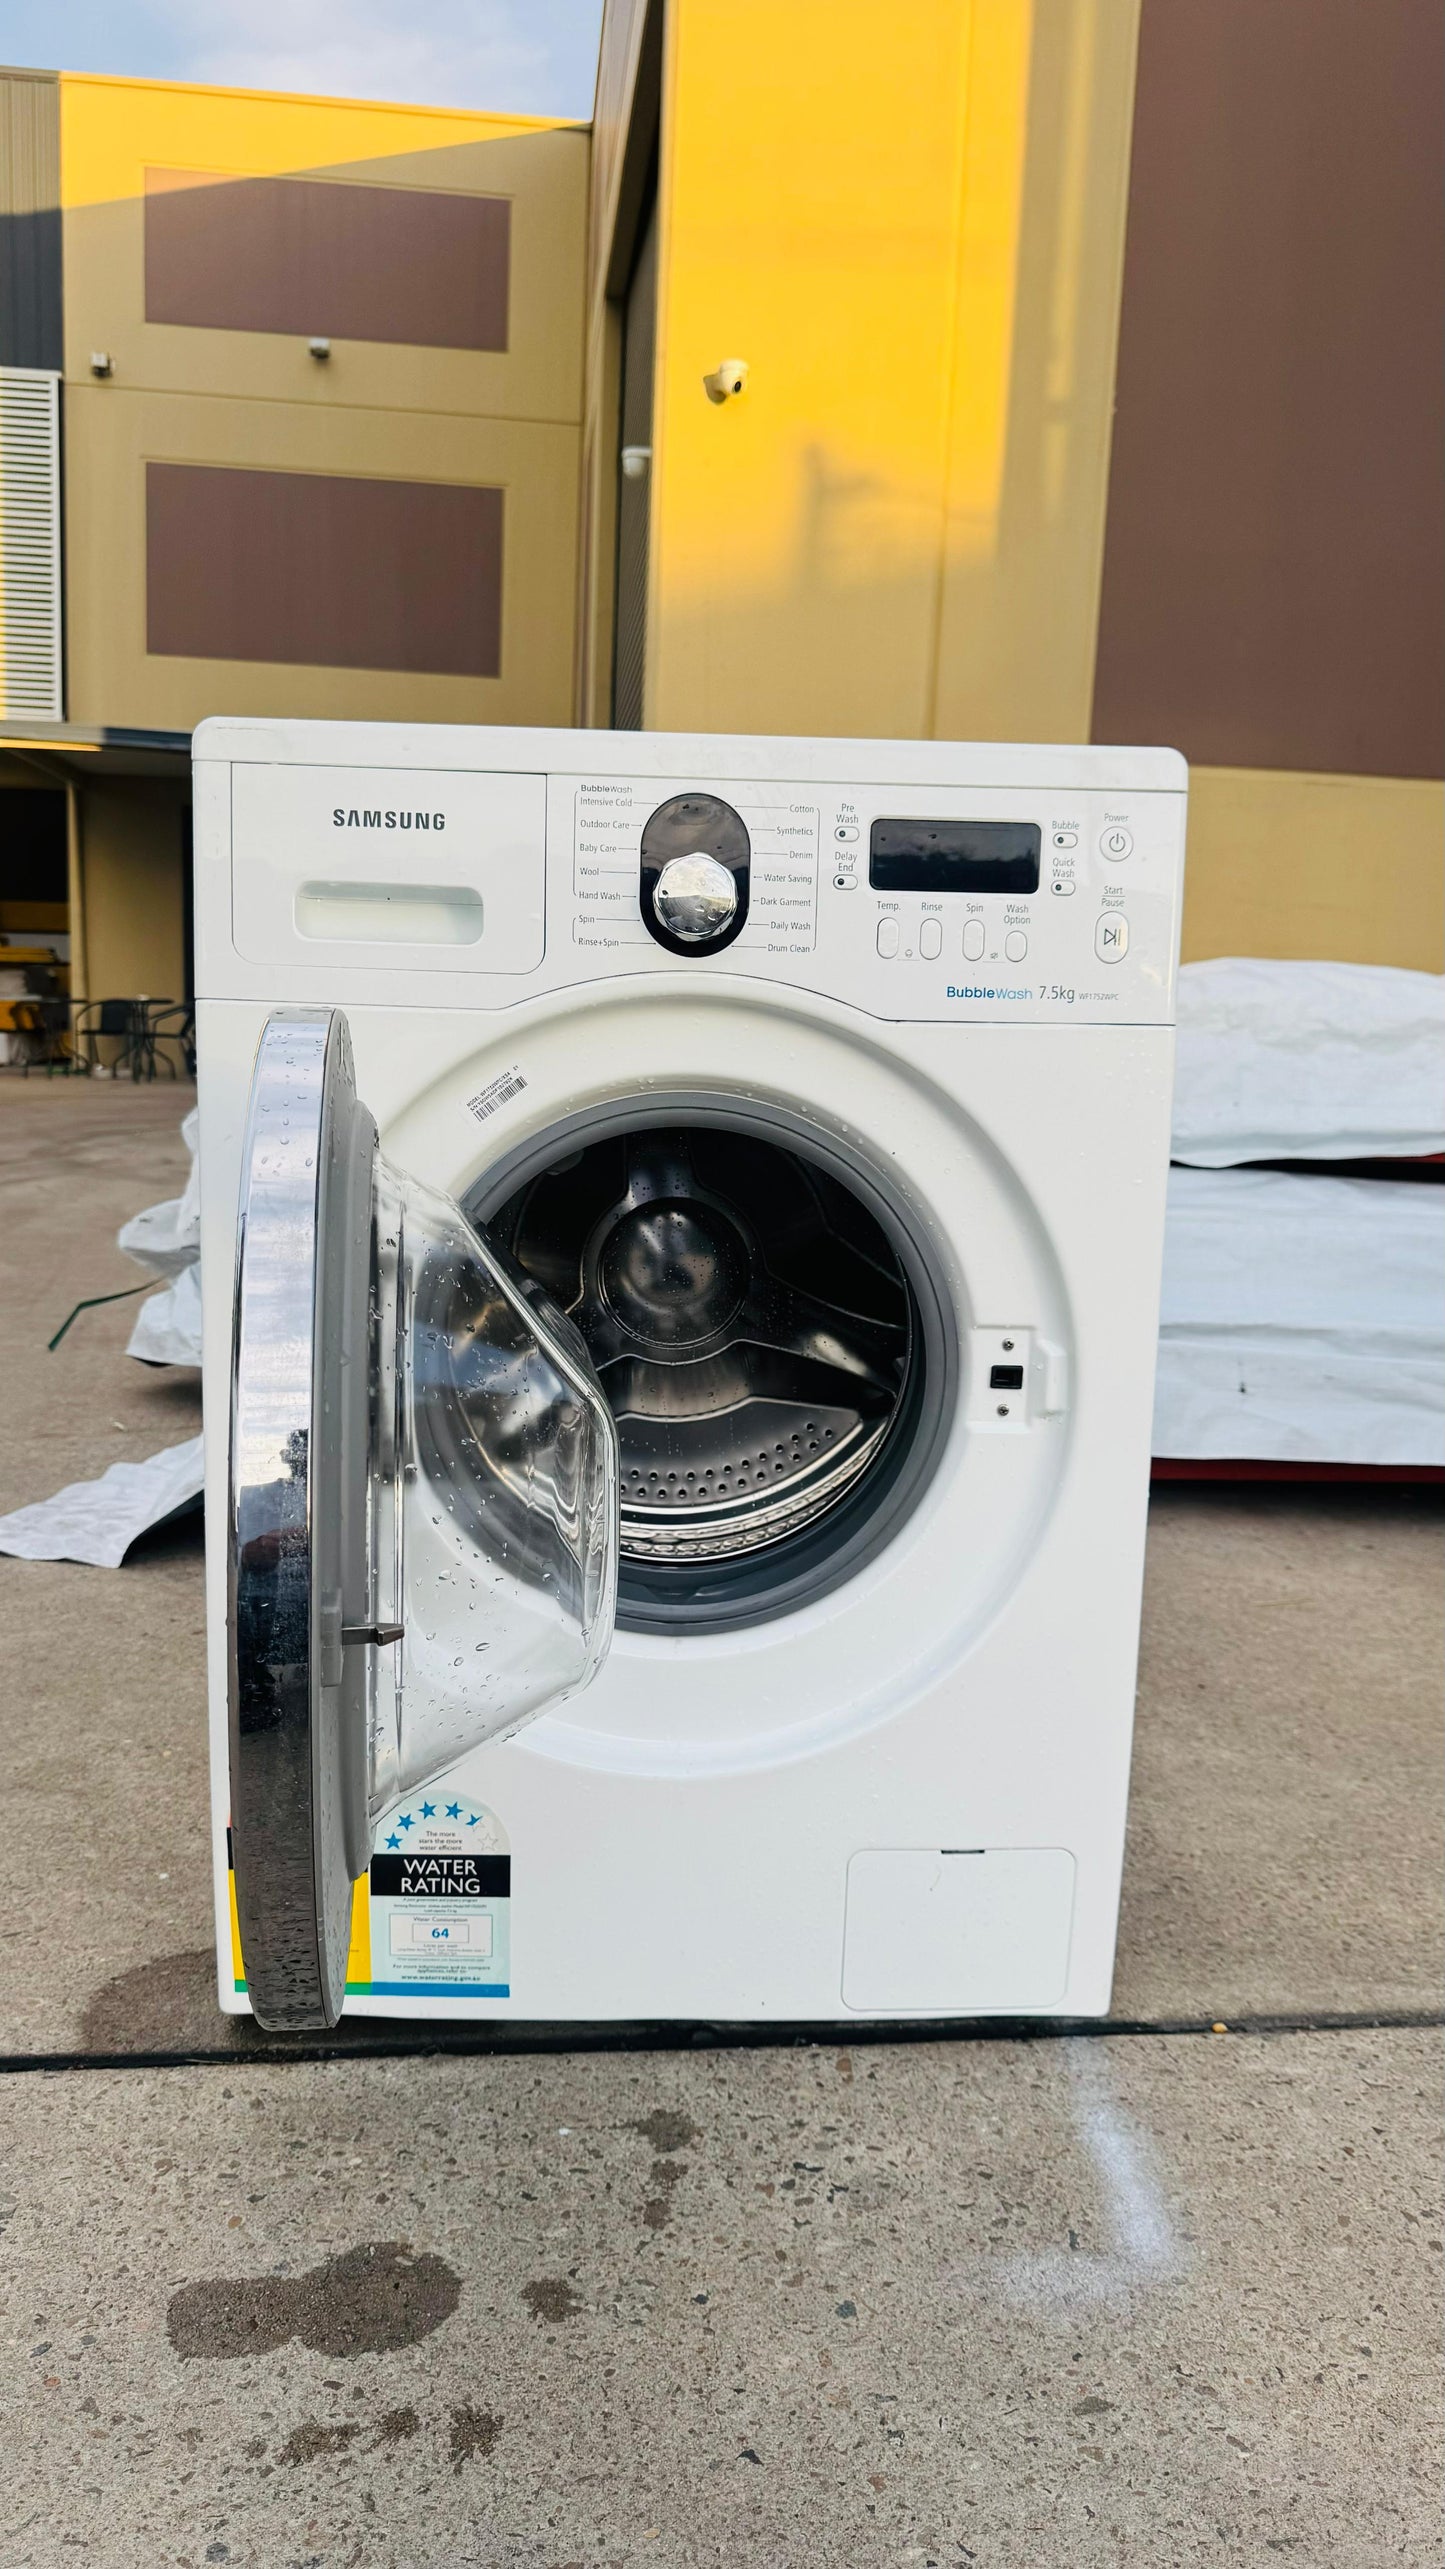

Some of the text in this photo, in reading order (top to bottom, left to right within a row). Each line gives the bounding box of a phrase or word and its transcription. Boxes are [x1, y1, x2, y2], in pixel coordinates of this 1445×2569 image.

[581, 784, 632, 794] BubbleWash
[580, 798, 632, 807] Intensive Cold
[790, 805, 815, 813] Cotton
[841, 803, 854, 813] Pre
[333, 808, 445, 831] SAMSUNG
[836, 814, 859, 824] Wash
[1104, 814, 1129, 822] Power
[580, 820, 630, 829] Outdoor Care
[1052, 821, 1079, 830] Bubble
[776, 827, 814, 836] Synthetics
[580, 844, 617, 853] Baby Care
[790, 851, 813, 859] Denim
[835, 852, 857, 863] Delay
[838, 862, 853, 872] End
[1053, 858, 1075, 867] Quick
[580, 868, 599, 876] Wool
[1052, 869, 1075, 878] Wash
[764, 875, 812, 884] Water Saving
[1104, 885, 1123, 894] Start
[579, 891, 621, 901] Hand Wash
[760, 897, 811, 906] Dark Garment
[1102, 898, 1124, 907] Pause
[877, 902, 901, 912] Temp.
[921, 902, 943, 912] Rinse
[966, 903, 983, 914] Spin
[1006, 904, 1029, 914] Wash
[579, 915, 595, 924] Spin
[1003, 914, 1031, 925] Option
[770, 922, 811, 931] Daily Wash
[578, 938, 619, 948] Rinse+Spin
[768, 944, 810, 953] Drum Clean
[947, 986, 1032, 1000] BubbleWash
[1039, 985, 1075, 1003] 7.5kg
[403, 1859, 478, 1876] WATER
[401, 1877, 480, 1894] RATING
[431, 1927, 450, 1939] 64
